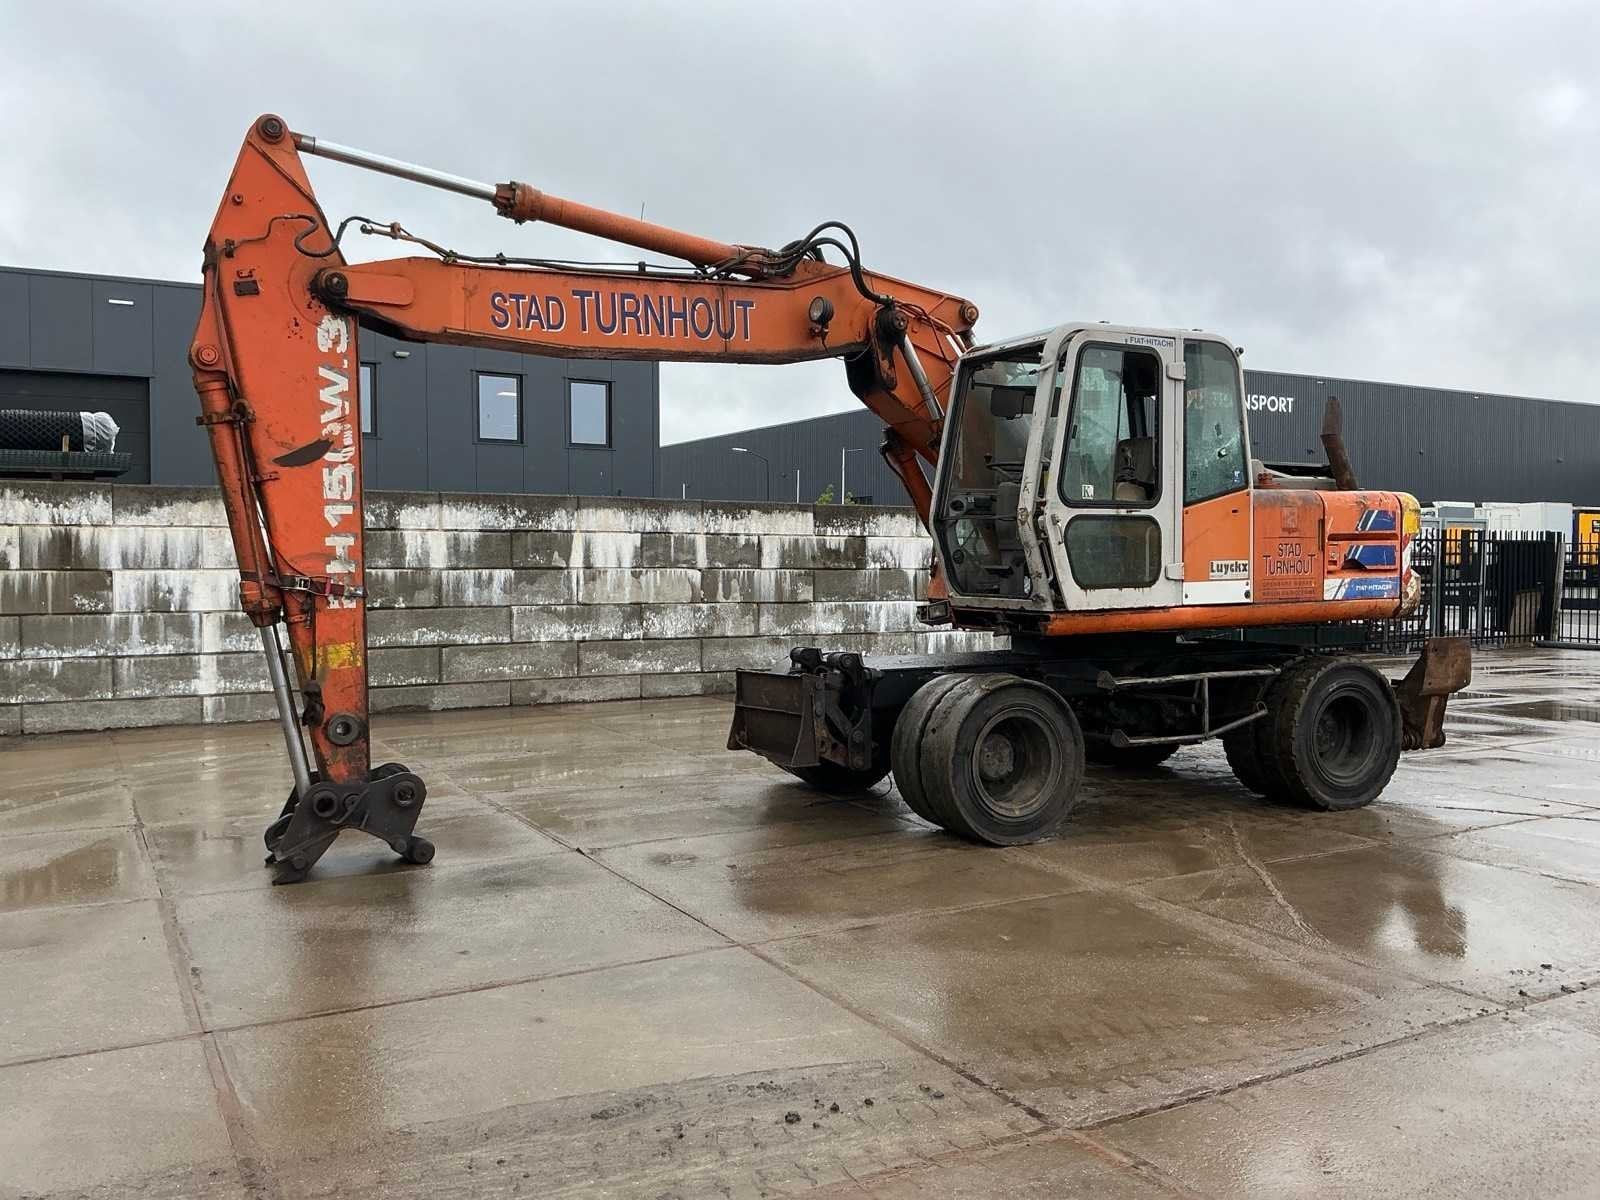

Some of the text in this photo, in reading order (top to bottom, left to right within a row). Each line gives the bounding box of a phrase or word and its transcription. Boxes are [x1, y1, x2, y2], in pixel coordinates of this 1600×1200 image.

[490, 290, 756, 341] STAD TURNHOUT
[1129, 336, 1174, 348] FIAT-HITACHI
[1278, 543, 1302, 558] STAD
[1210, 561, 1248, 575] Luyckx
[1262, 554, 1316, 576] TURNHOUT
